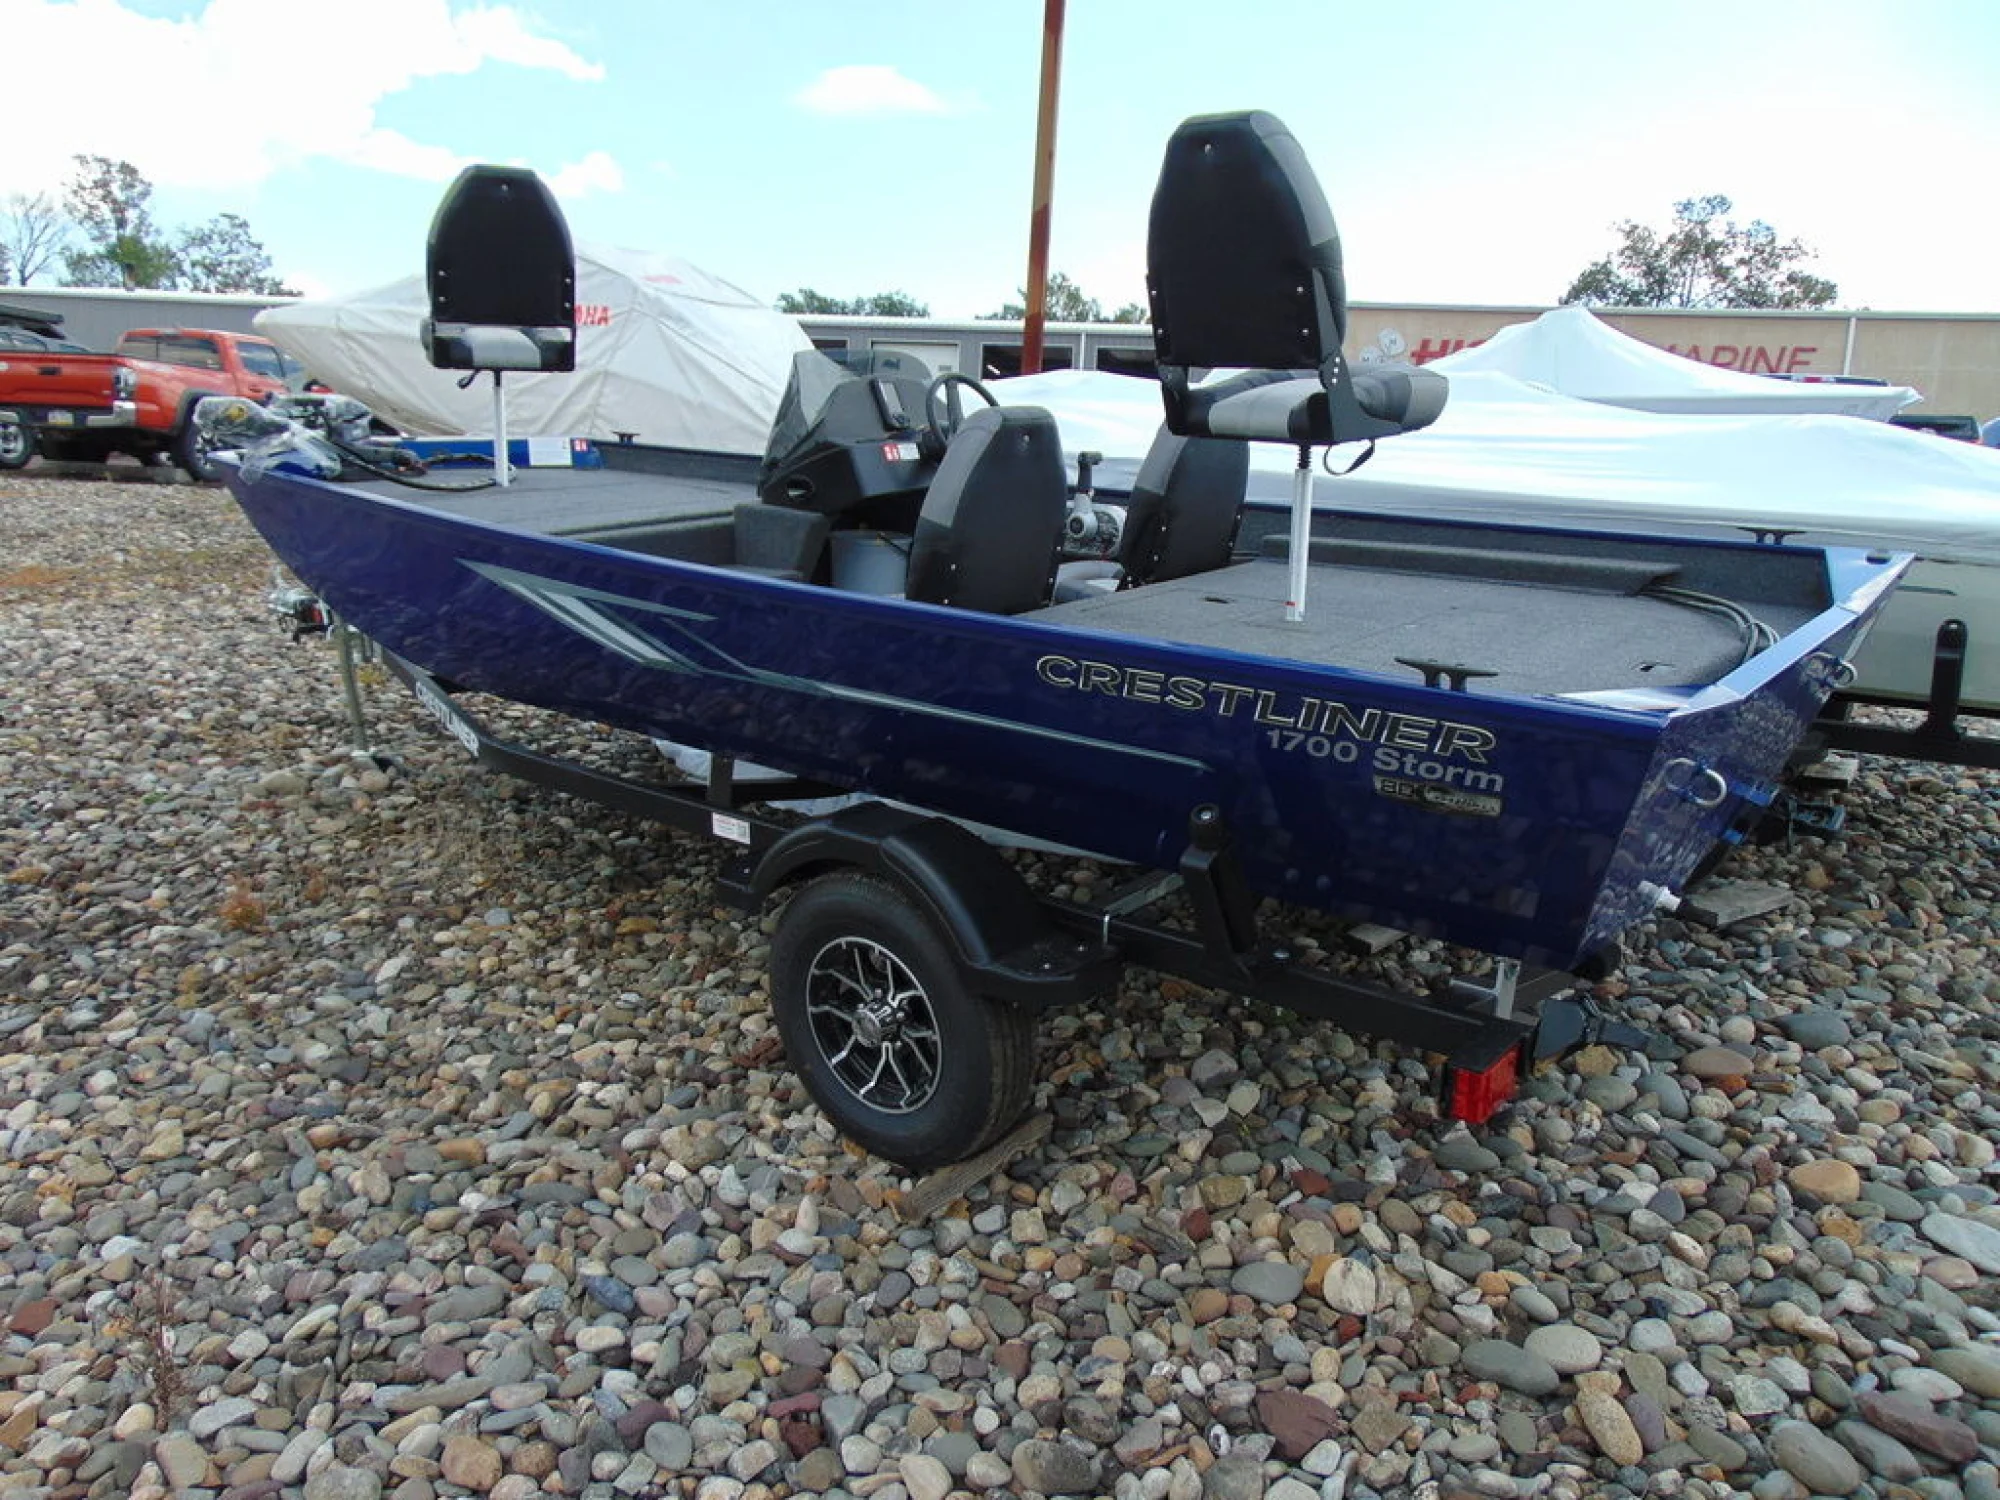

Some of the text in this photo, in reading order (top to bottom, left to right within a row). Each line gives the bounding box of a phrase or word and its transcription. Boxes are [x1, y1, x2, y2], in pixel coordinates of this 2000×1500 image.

[574, 303, 610, 326] AHA
[1666, 344, 1819, 374] RINE
[1036, 655, 1496, 763] CRESTLINER
[1266, 729, 1504, 792] 1700 Storm
